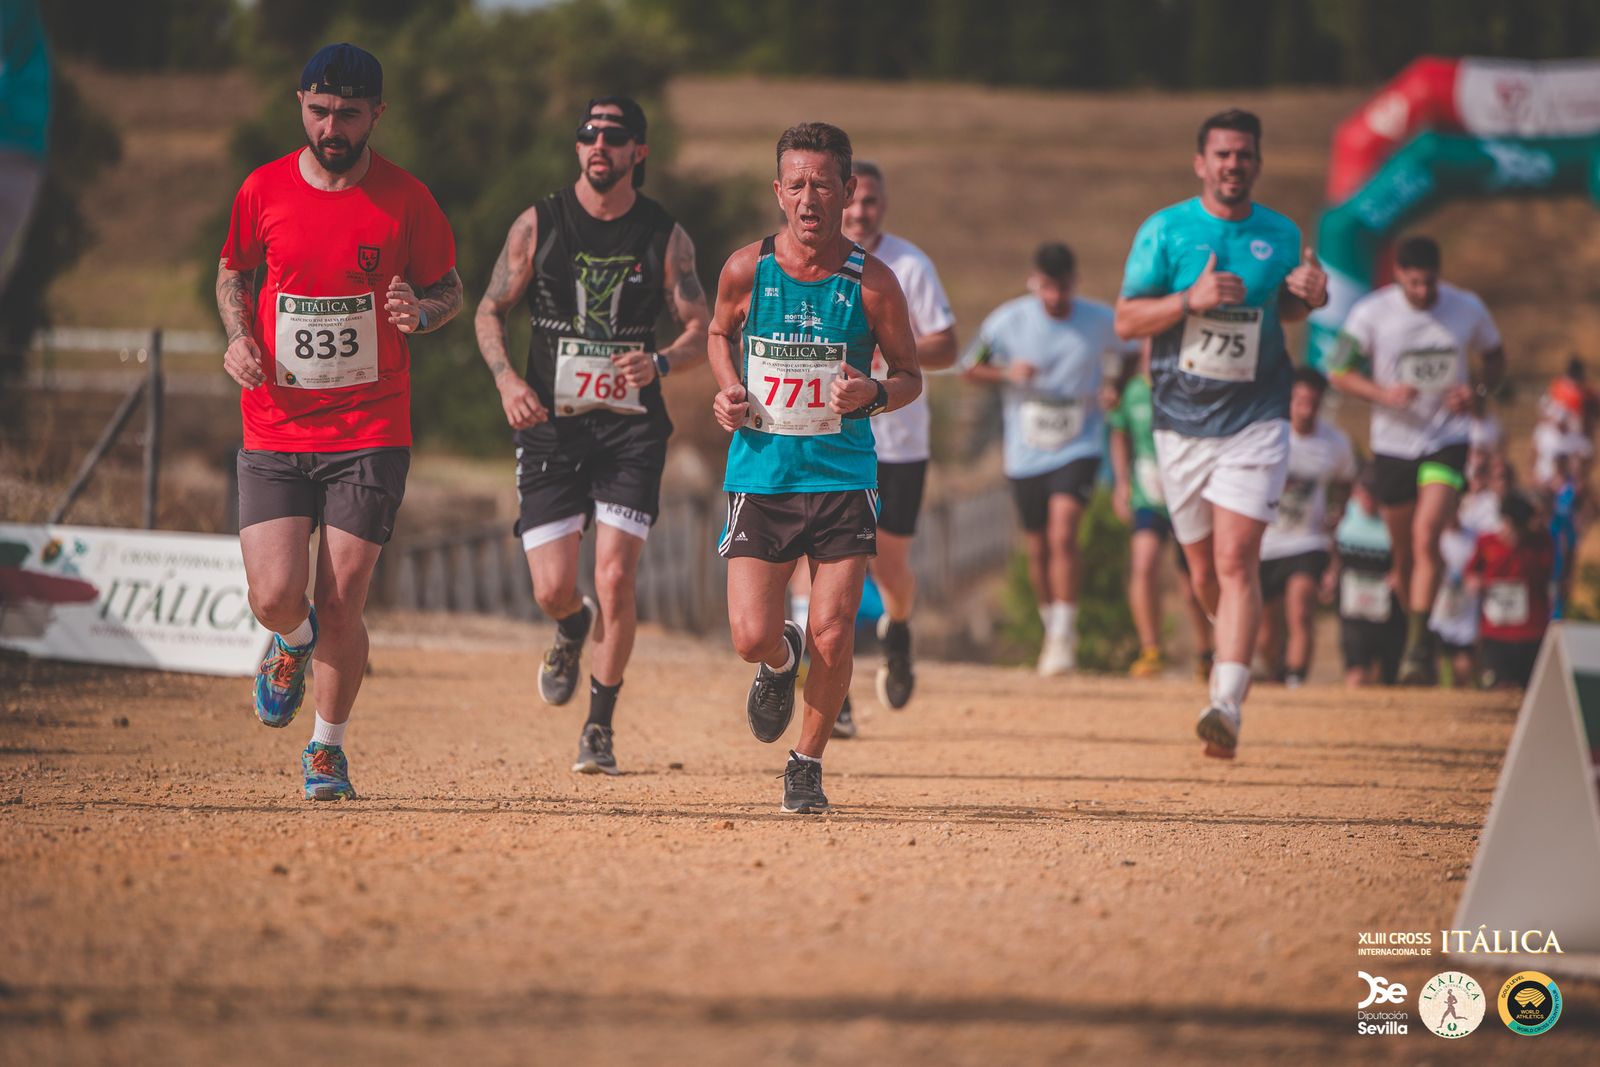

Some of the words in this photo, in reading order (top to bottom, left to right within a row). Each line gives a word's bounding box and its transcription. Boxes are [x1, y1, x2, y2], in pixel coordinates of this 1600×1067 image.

[301, 299, 348, 313] ITÁLICA
[294, 328, 360, 360] 833
[770, 344, 818, 358] ITÁLICA
[1200, 329, 1246, 358] 775
[575, 372, 628, 400] 768
[764, 375, 826, 408] 771
[99, 568, 258, 632] ITÁLICA
